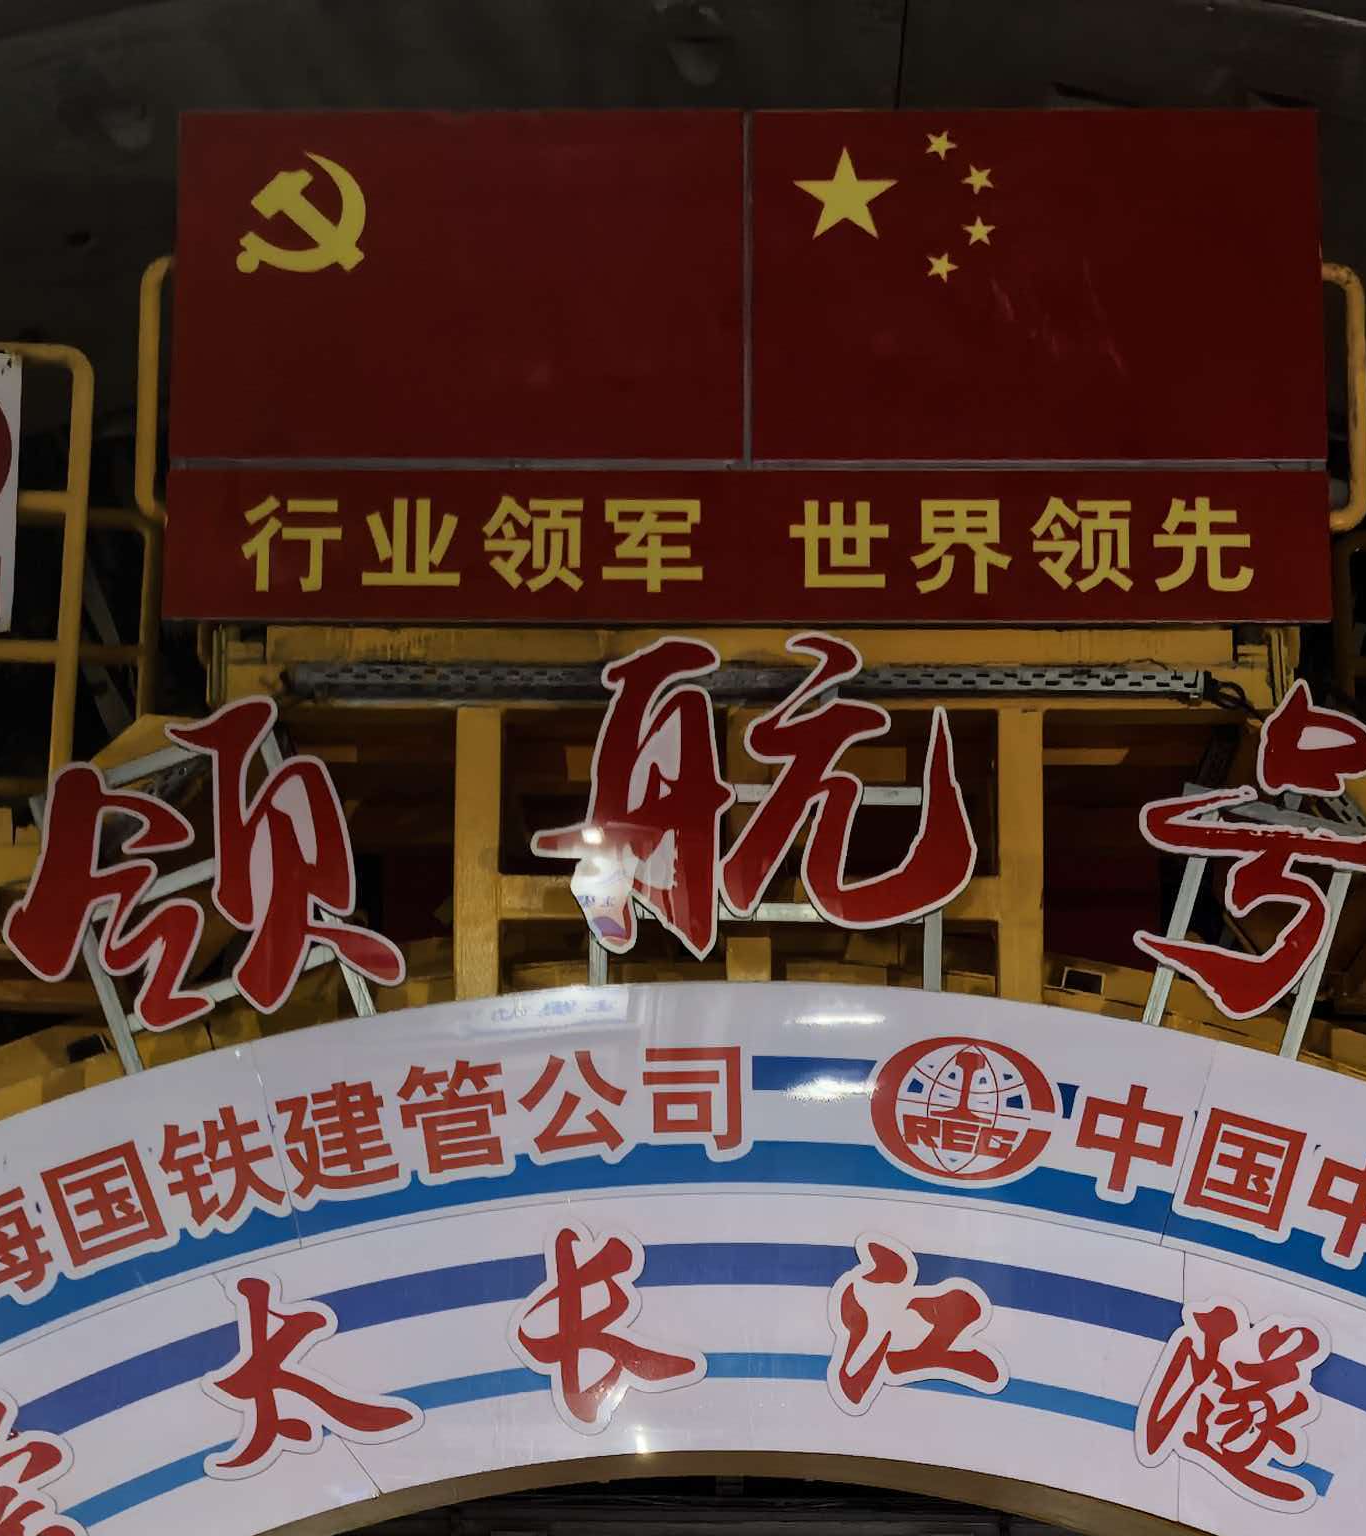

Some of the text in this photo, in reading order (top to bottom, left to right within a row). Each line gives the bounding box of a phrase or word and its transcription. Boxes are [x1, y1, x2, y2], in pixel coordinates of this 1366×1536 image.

[240, 495, 1257, 595] 行业领军 世界领先
